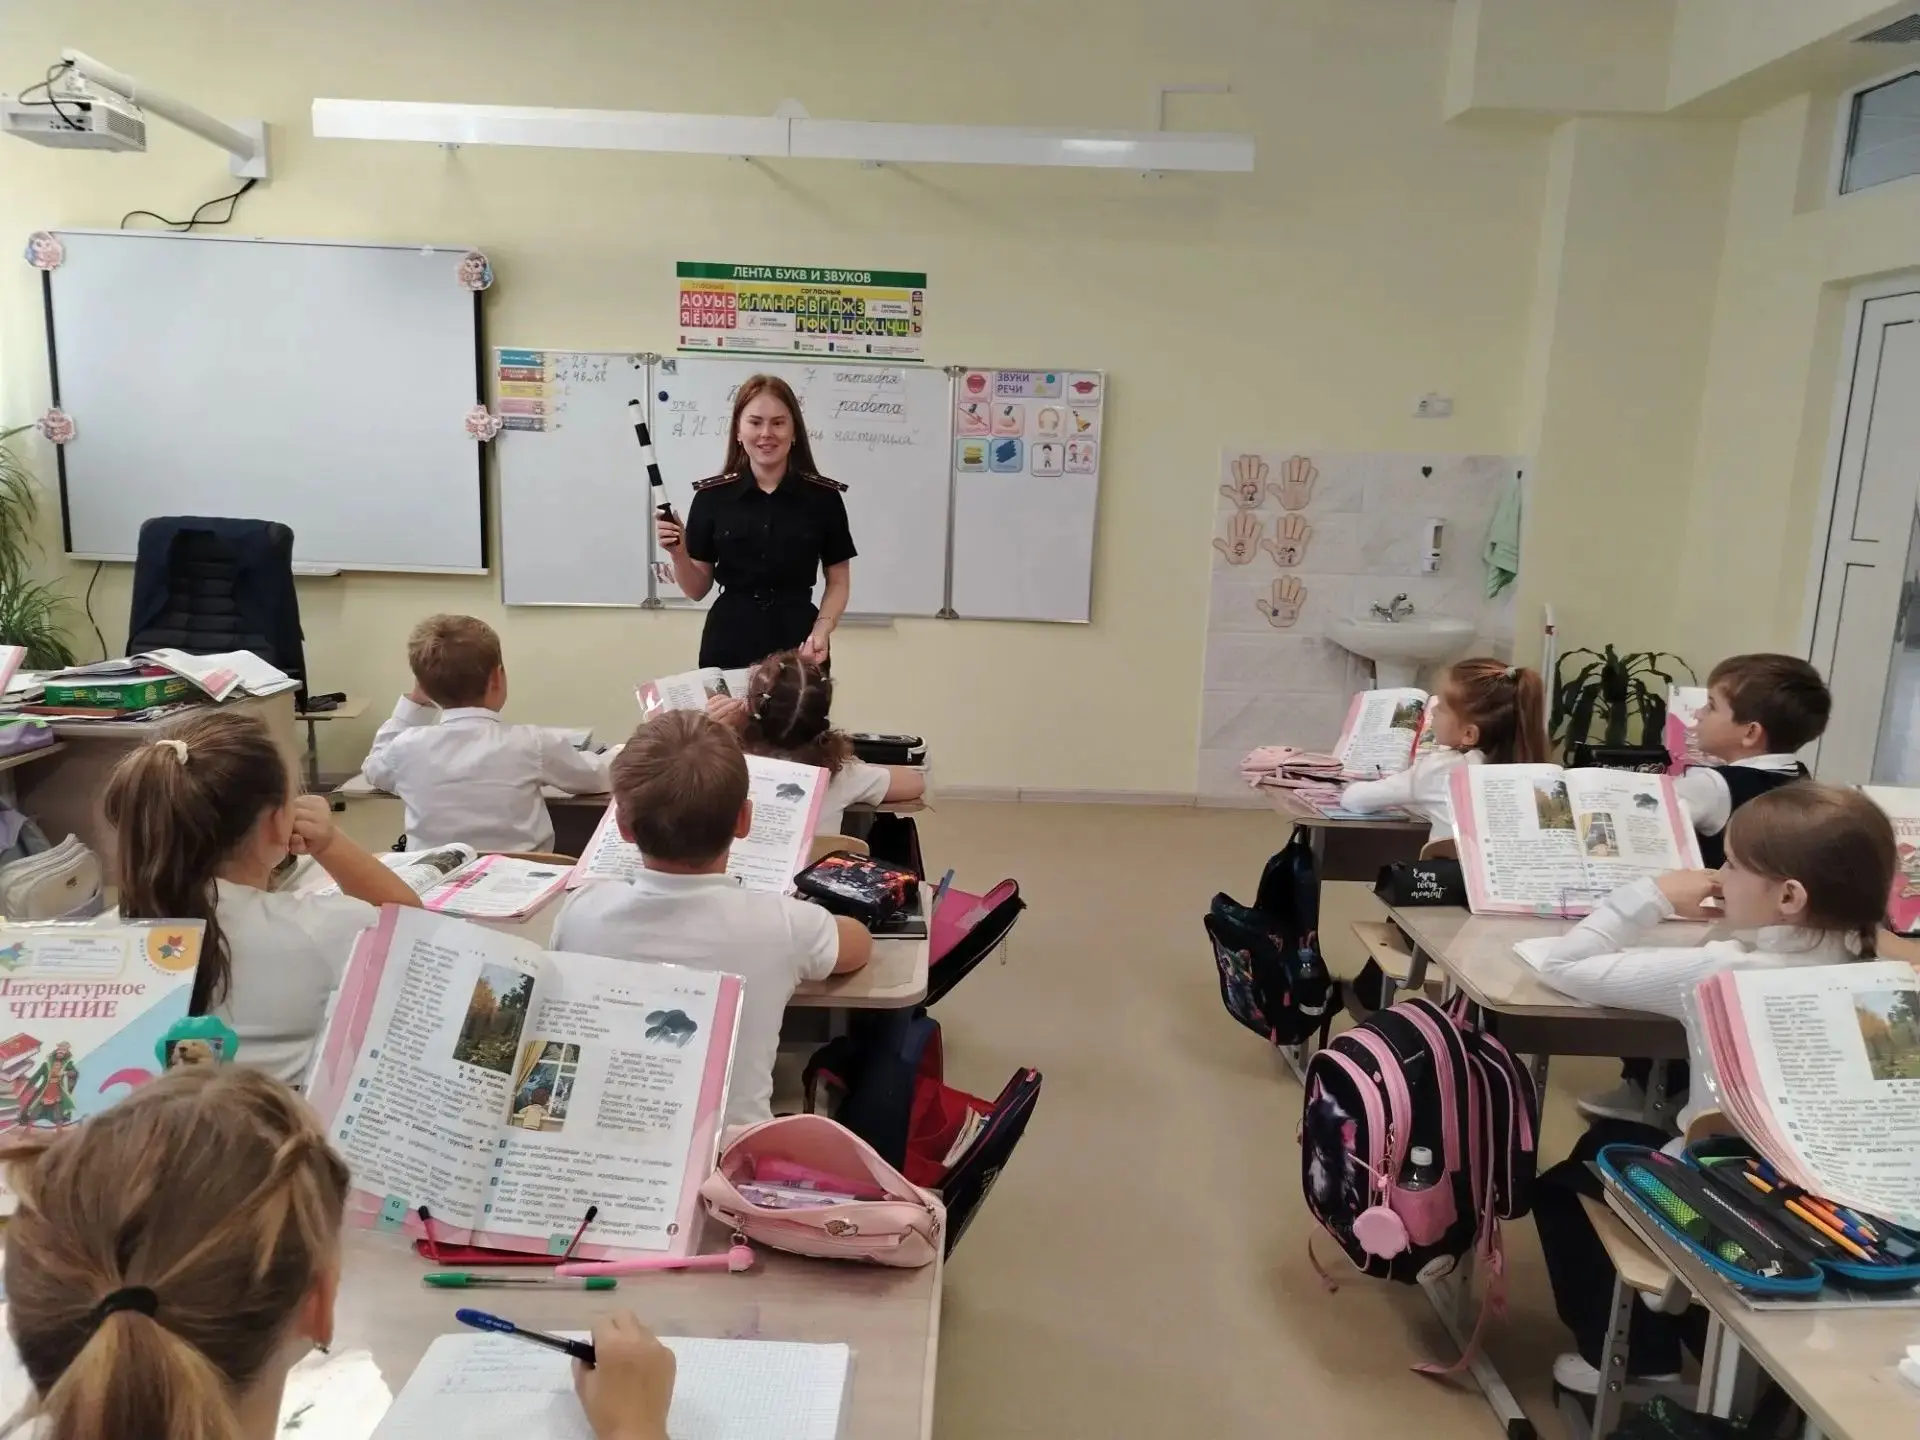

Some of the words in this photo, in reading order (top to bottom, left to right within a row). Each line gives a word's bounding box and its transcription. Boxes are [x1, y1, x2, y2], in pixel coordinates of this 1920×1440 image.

[733, 266, 772, 278] ЛЕНТА
[775, 268, 807, 281] БУКВ
[811, 270, 820, 281] И
[824, 271, 871, 283] ЗВУКОВ
[801, 287, 841, 296] согласные
[804, 368, 816, 385] 7
[835, 367, 899, 389] октября
[997, 373, 1029, 383] ЗВУКИ
[997, 384, 1024, 394] РЕЧИ
[831, 393, 905, 419] работа
[1411, 887, 1448, 899] moment
[0, 978, 146, 999] Литературное
[9, 1000, 119, 1019] ЧТЕНИЕ
[559, 1239, 570, 1247] 63
